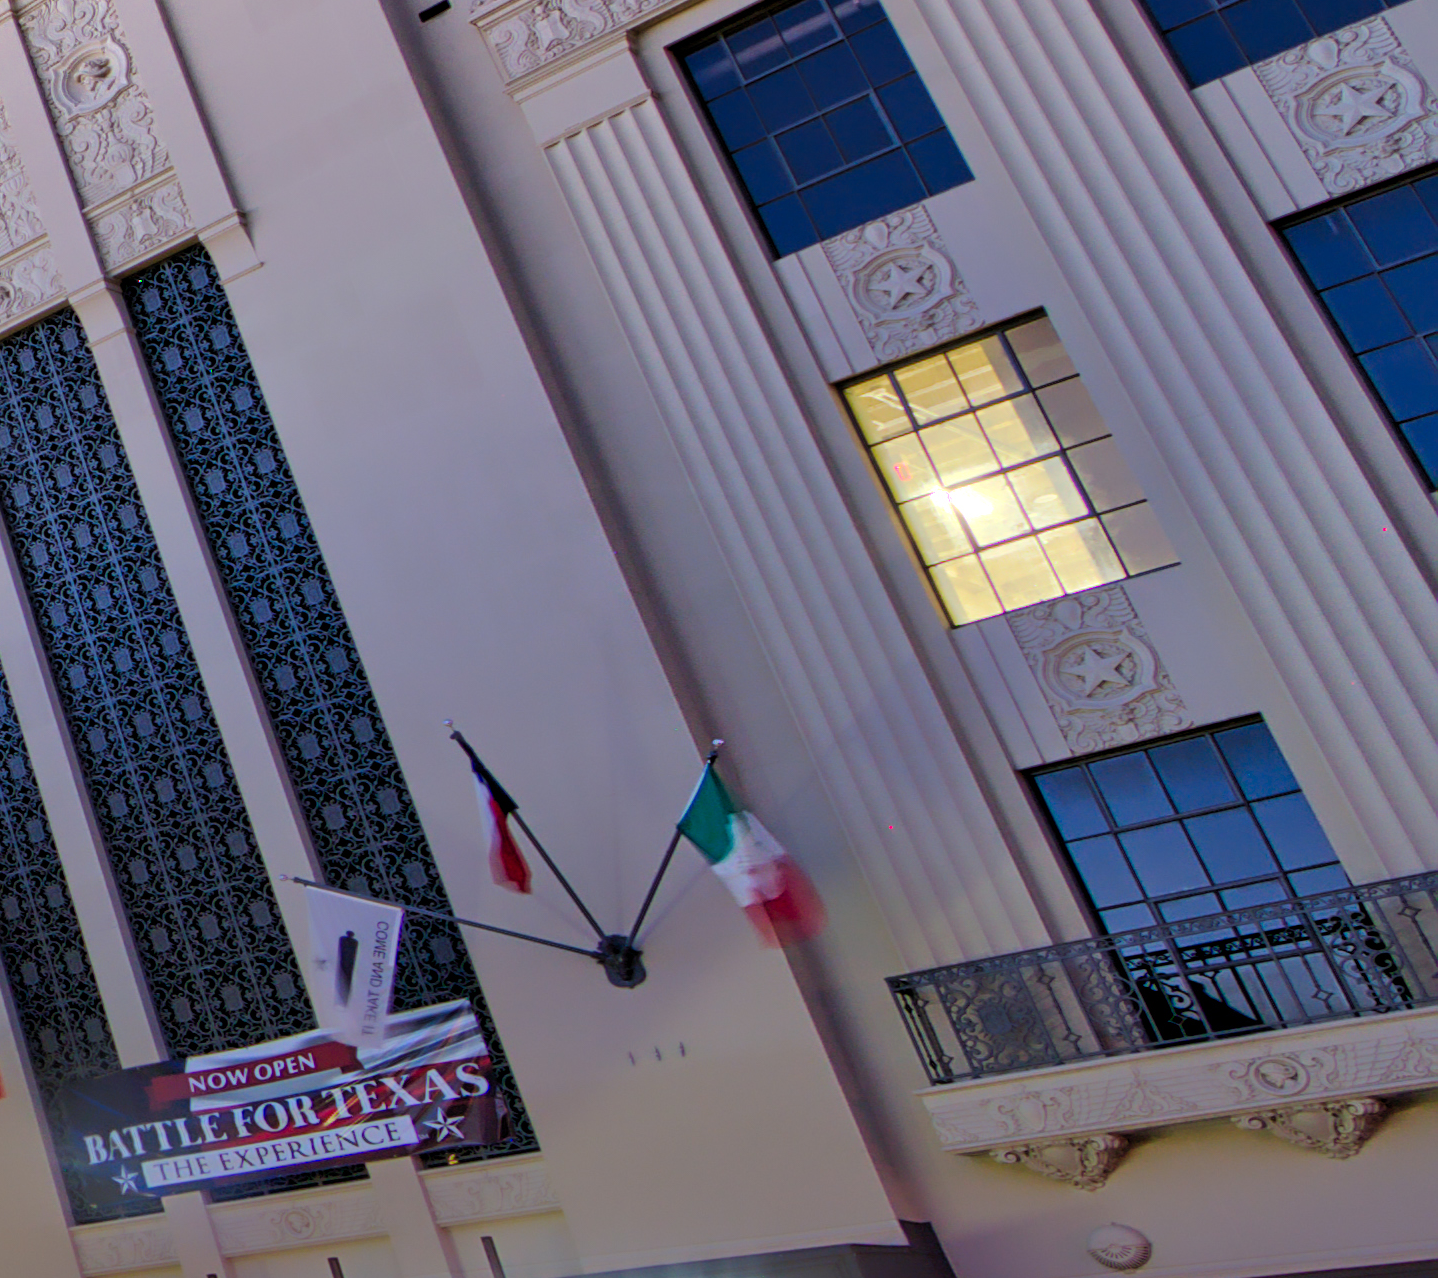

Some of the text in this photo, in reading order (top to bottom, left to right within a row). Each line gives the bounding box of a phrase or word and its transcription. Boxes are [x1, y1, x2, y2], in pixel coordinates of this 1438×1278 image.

[187, 1052, 315, 1094] NOW OPEN
[83, 1062, 490, 1165] BATTLE FOR TEXAS
[153, 1122, 402, 1182] THE EXPERIENCE
